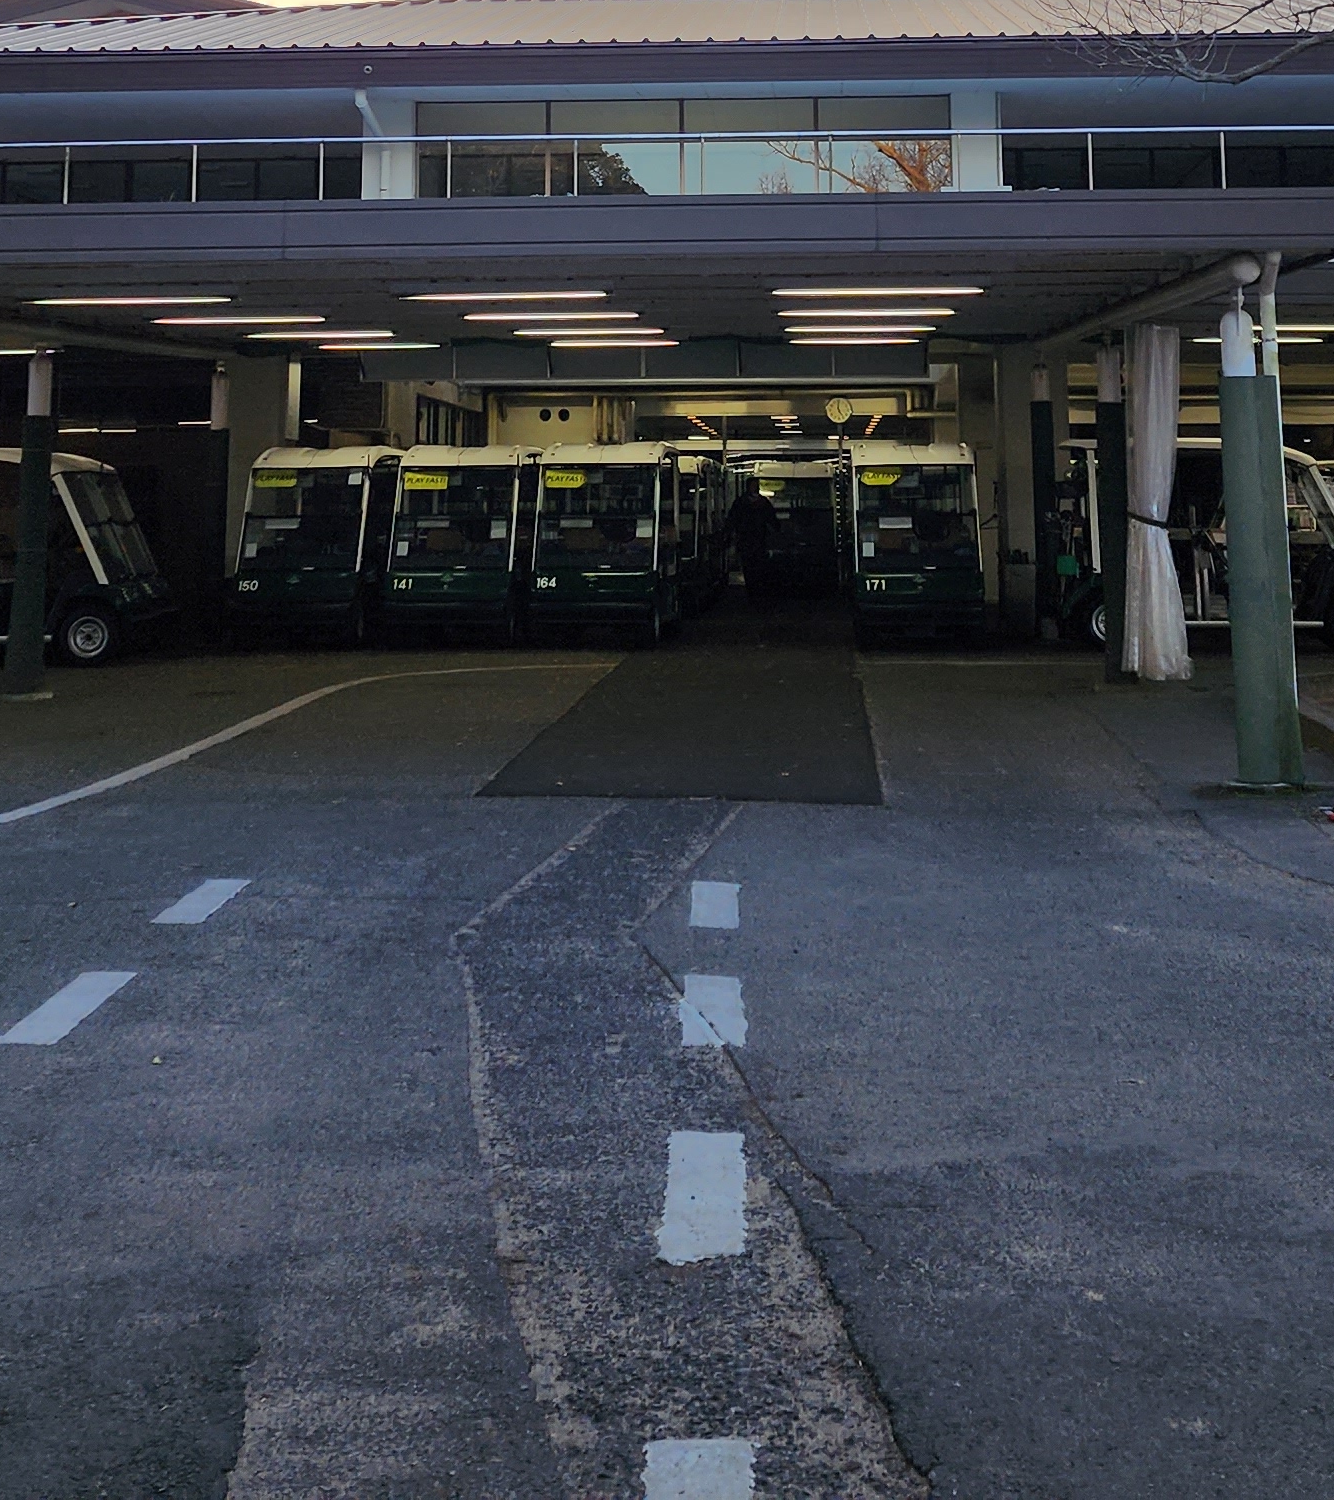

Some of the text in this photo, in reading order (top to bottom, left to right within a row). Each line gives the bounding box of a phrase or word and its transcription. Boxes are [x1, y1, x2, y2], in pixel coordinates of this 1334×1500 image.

[238, 580, 259, 591] 150
[393, 579, 413, 590] 141
[536, 577, 557, 588] 164
[866, 579, 886, 591] 171
